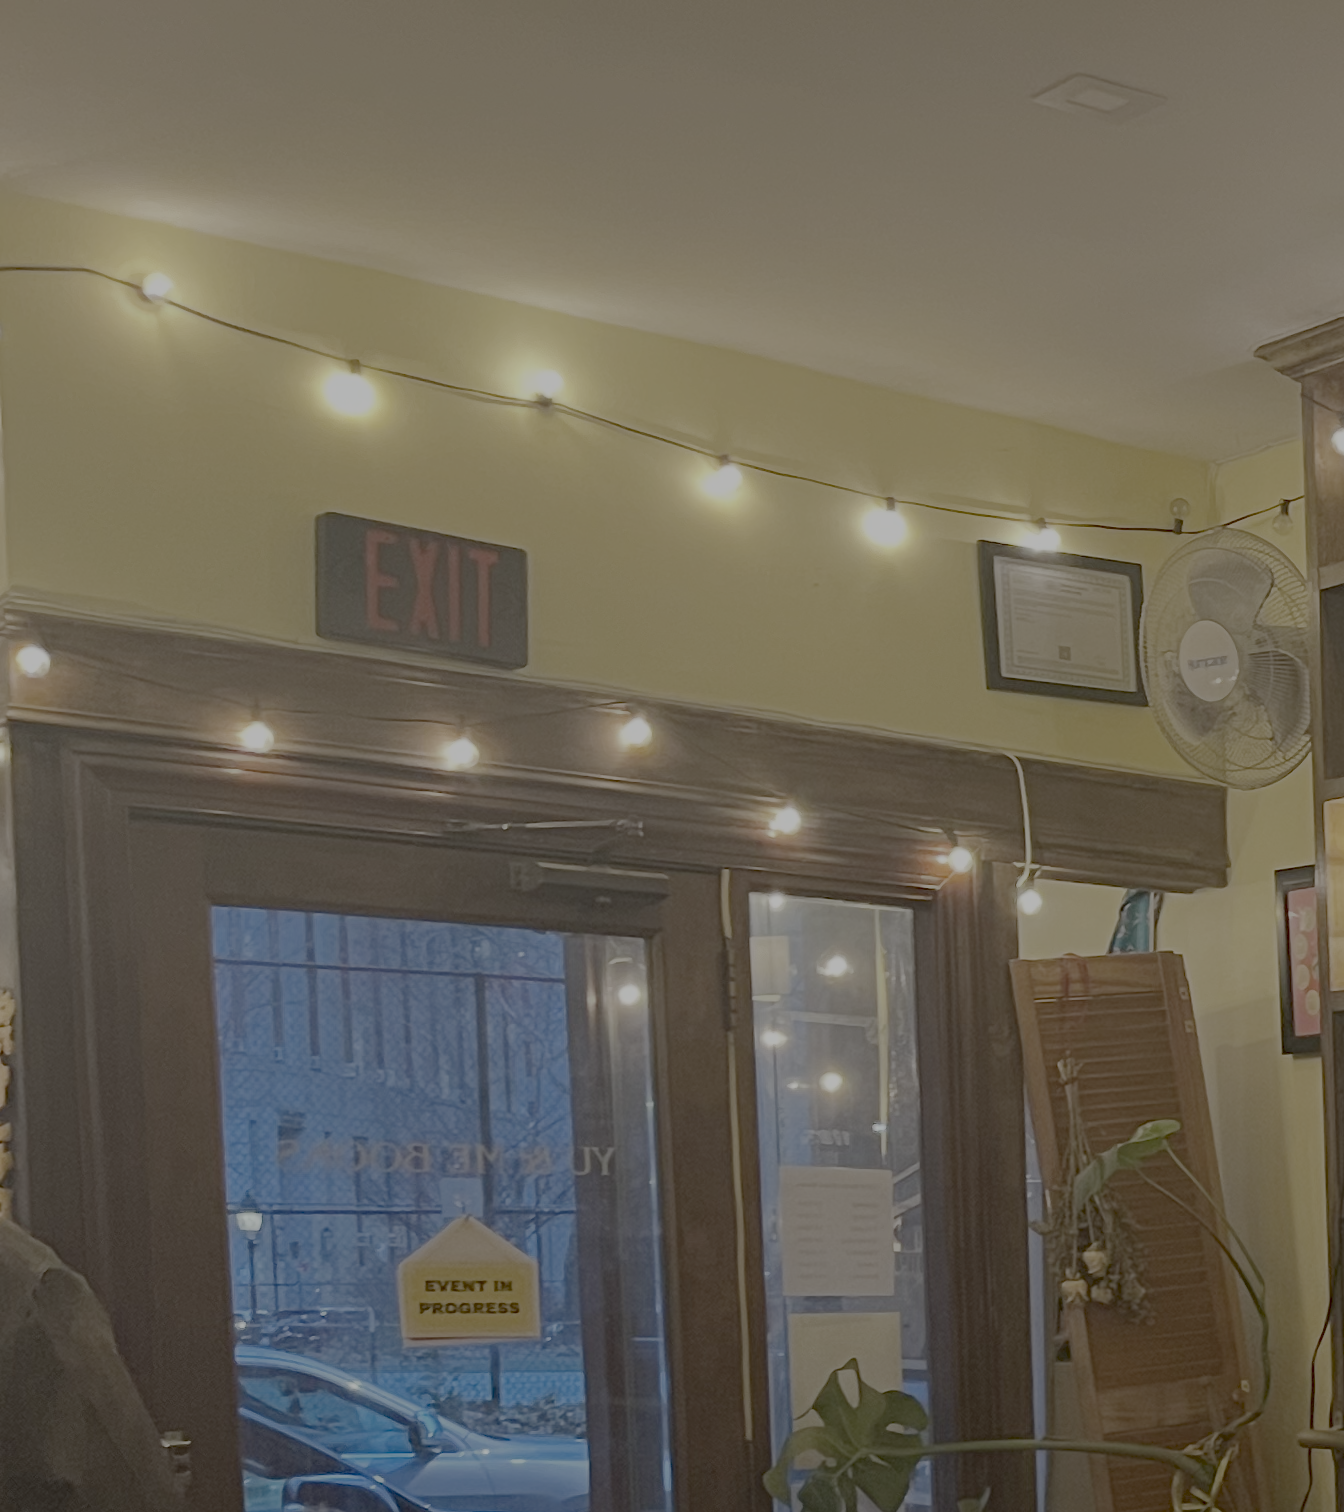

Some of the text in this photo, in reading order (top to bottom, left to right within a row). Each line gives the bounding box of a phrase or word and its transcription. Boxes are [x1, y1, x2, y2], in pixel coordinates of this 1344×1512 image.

[364, 529, 499, 648] EXIT
[424, 1280, 513, 1292] EVENT IN
[418, 1302, 520, 1315] PROGRESS
